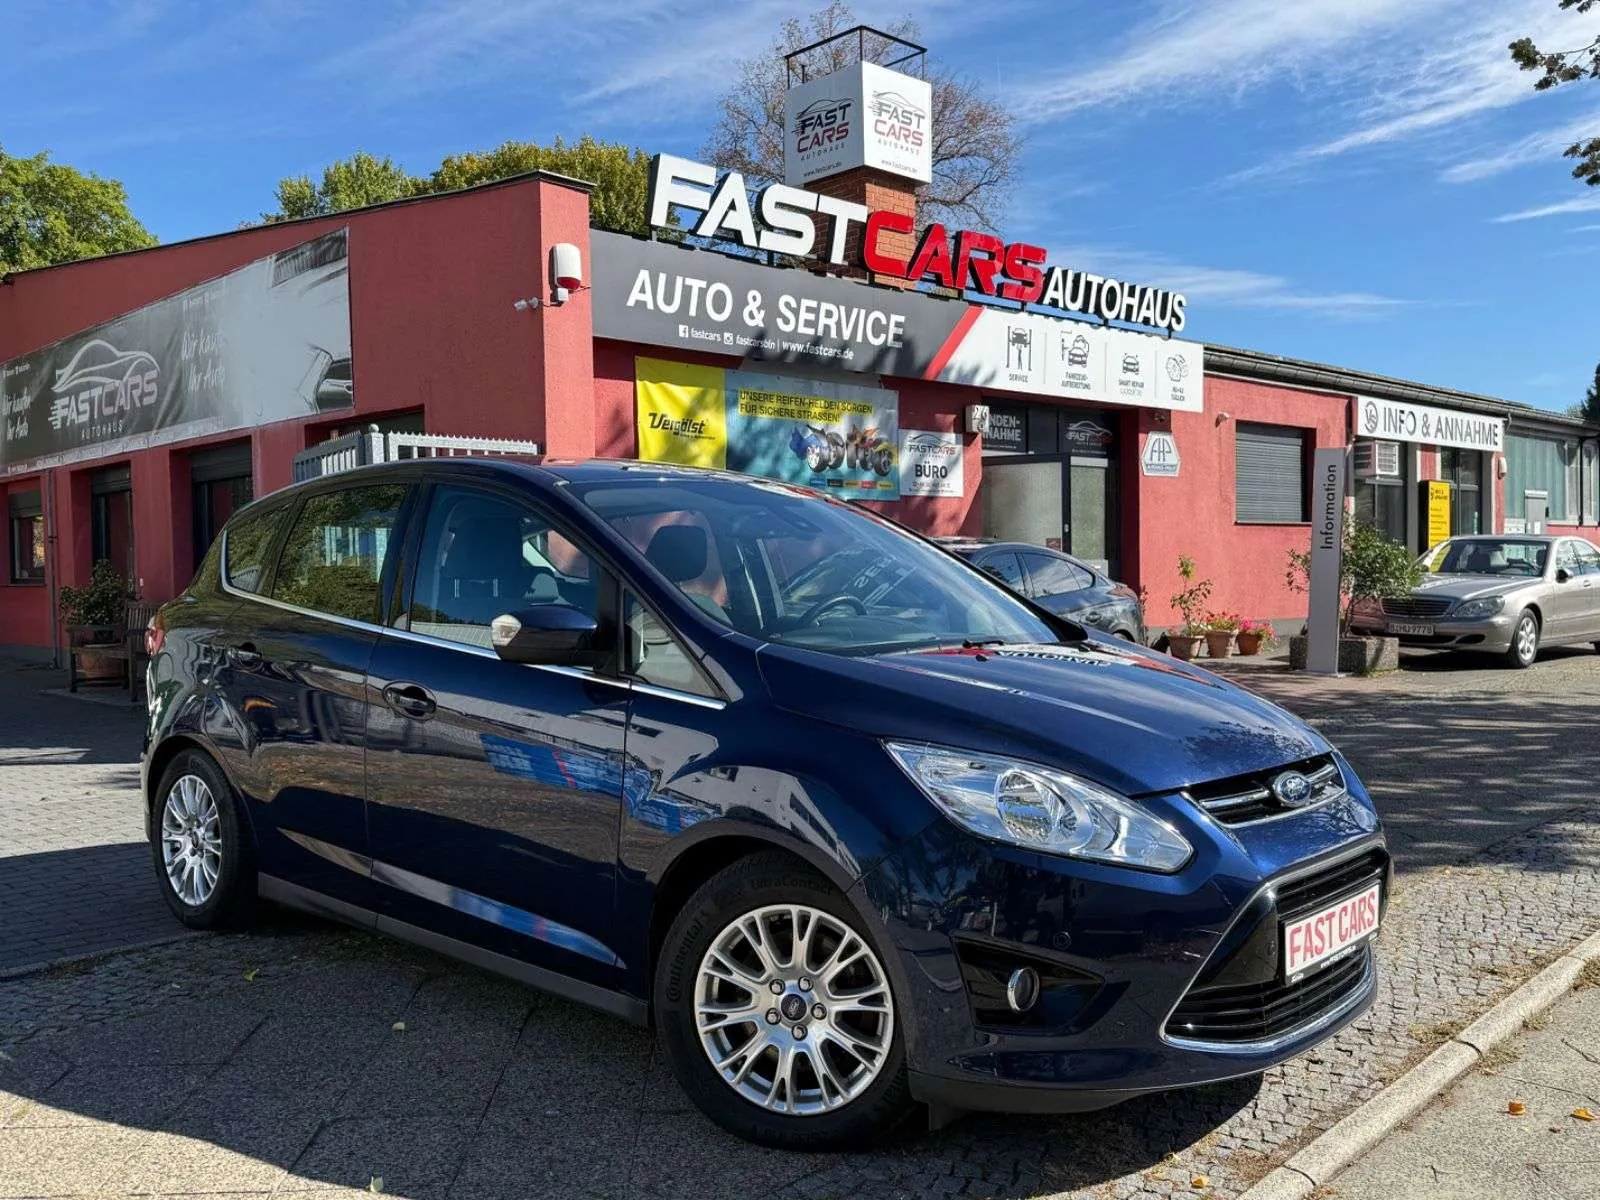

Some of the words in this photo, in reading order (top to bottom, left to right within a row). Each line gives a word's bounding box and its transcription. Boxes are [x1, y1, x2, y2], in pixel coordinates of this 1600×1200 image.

[796, 102, 852, 135] FAST
[871, 100, 925, 129] FAST
[797, 121, 850, 153] CARS
[873, 119, 924, 147] CARS
[649, 152, 868, 266] FAST
[863, 210, 1048, 303] CARS
[1042, 266, 1187, 333] AUTOHAUS
[626, 269, 734, 323] AUTO
[742, 289, 765, 328] &
[775, 294, 906, 348] SERVICE
[690, 327, 721, 342] fastcars
[782, 339, 854, 360] www.fastcars.de
[48, 369, 159, 430] FASTCARS
[740, 390, 776, 403] UNSERE
[840, 400, 873, 414] SORGEN
[740, 401, 757, 413] FÜR
[760, 405, 797, 418] SICHERE
[81, 420, 123, 441] AUTOHAUS
[648, 411, 706, 436] Vergölst
[1383, 406, 1417, 437] INFO
[1421, 412, 1431, 439] &
[1434, 415, 1499, 447] ANNAHME
[914, 460, 948, 479] BÜRO
[1319, 464, 1337, 549] Information
[1289, 911, 1336, 968] FAST
[1338, 891, 1376, 940] CARS
